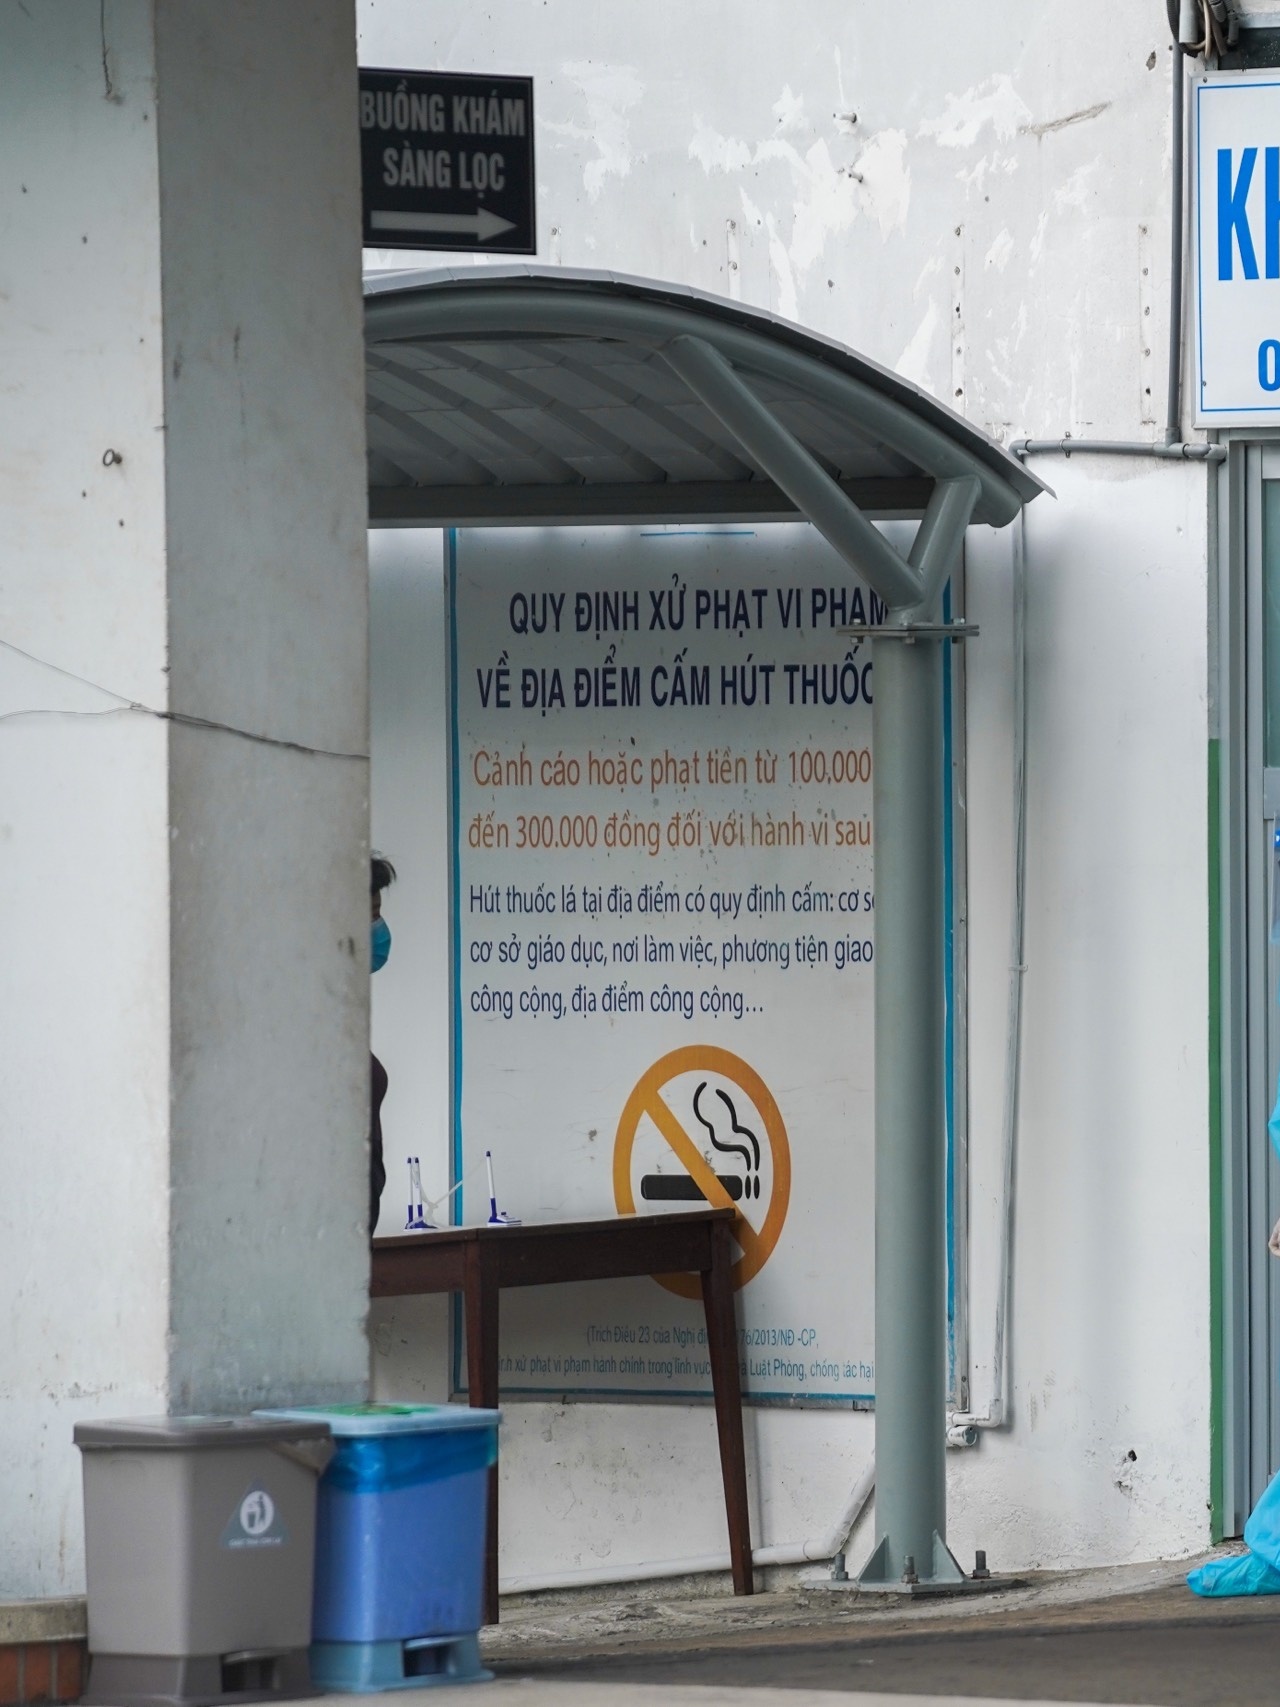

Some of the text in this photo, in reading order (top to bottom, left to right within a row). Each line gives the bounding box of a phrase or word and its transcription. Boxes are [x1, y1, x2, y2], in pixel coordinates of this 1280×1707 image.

[360, 79, 526, 137] BUỒNG KHÁM
[383, 140, 505, 199] SÀNG LỌC
[509, 592, 566, 635] QUY
[574, 590, 640, 641] ĐỊNH
[648, 572, 687, 632] XỬ
[695, 588, 768, 638] PHẠT
[776, 587, 801, 629] VI
[476, 643, 873, 717] VỀ ĐỊA ĐIỂM CẤM HÚT THUỐC
[474, 746, 871, 793] Cảnh cáo hoặc phạt tiền từ 100.000
[468, 809, 871, 856] đến 300.000 đồng đối với hành vi sau
[470, 884, 501, 913] Hút
[506, 882, 556, 913] thuốc
[561, 884, 577, 913] lá
[582, 885, 602, 919] tại
[607, 884, 632, 920] địa
[637, 881, 680, 913] điểm
[685, 884, 705, 912] có
[710, 891, 742, 920] quy
[747, 883, 785, 919] định
[792, 881, 834, 912] cấm:
[838, 889, 860, 912] cơ
[470, 933, 873, 970] cơ sở giáo dục, nơi làm việc, phương tiện giao
[470, 983, 513, 1020] công
[519, 985, 567, 1020] cộng,
[571, 983, 597, 1019] địa
[601, 980, 644, 1013] điểm
[650, 983, 694, 1020] công
[638, 1326, 650, 1344] 23
[672, 1326, 695, 1349] Nghị
[530, 1355, 551, 1377] phạt
[563, 1354, 591, 1377] phạm
[648, 1359, 673, 1378] trong
